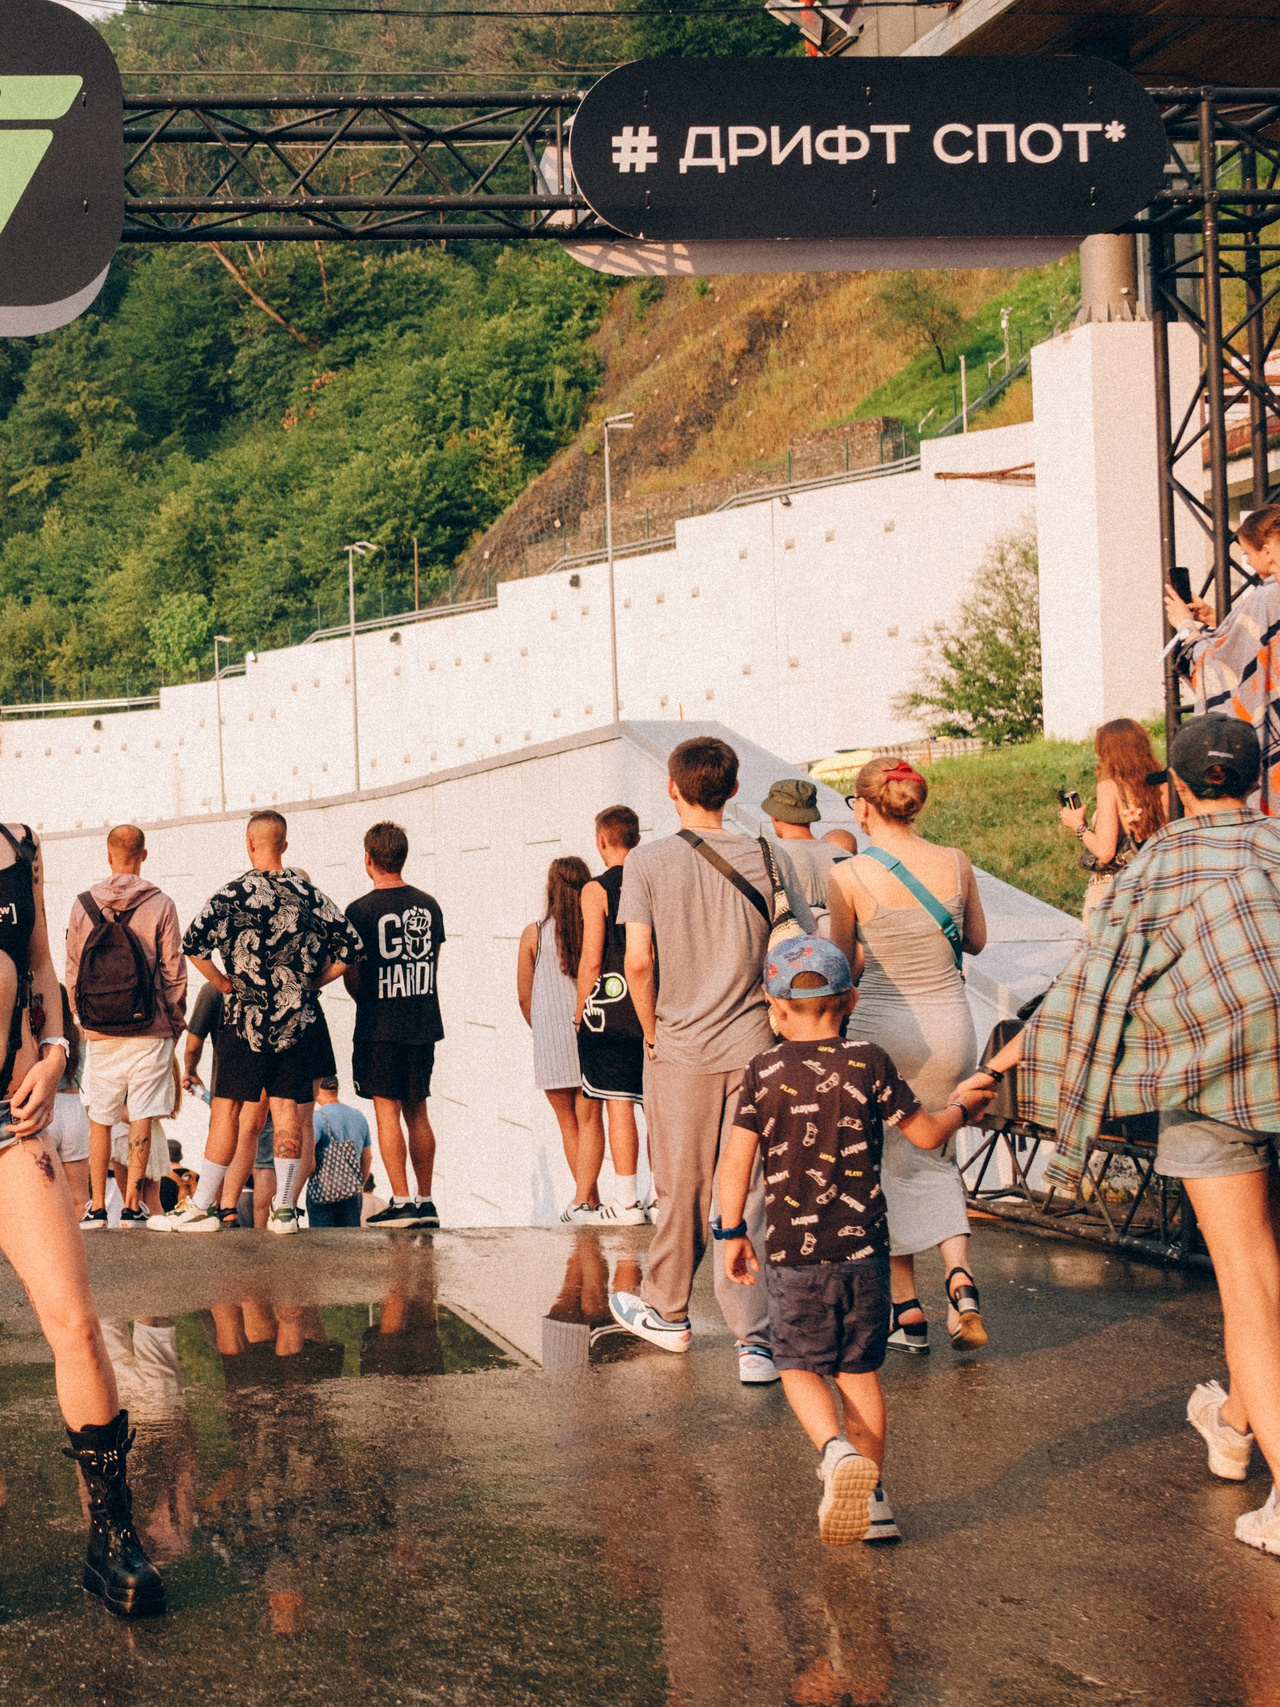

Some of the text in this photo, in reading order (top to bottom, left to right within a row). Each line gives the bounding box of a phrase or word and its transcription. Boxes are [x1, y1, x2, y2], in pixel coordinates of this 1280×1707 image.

[611, 126, 658, 173] #
[678, 124, 910, 174] ДРИФТ
[378, 961, 434, 999] HARD!
